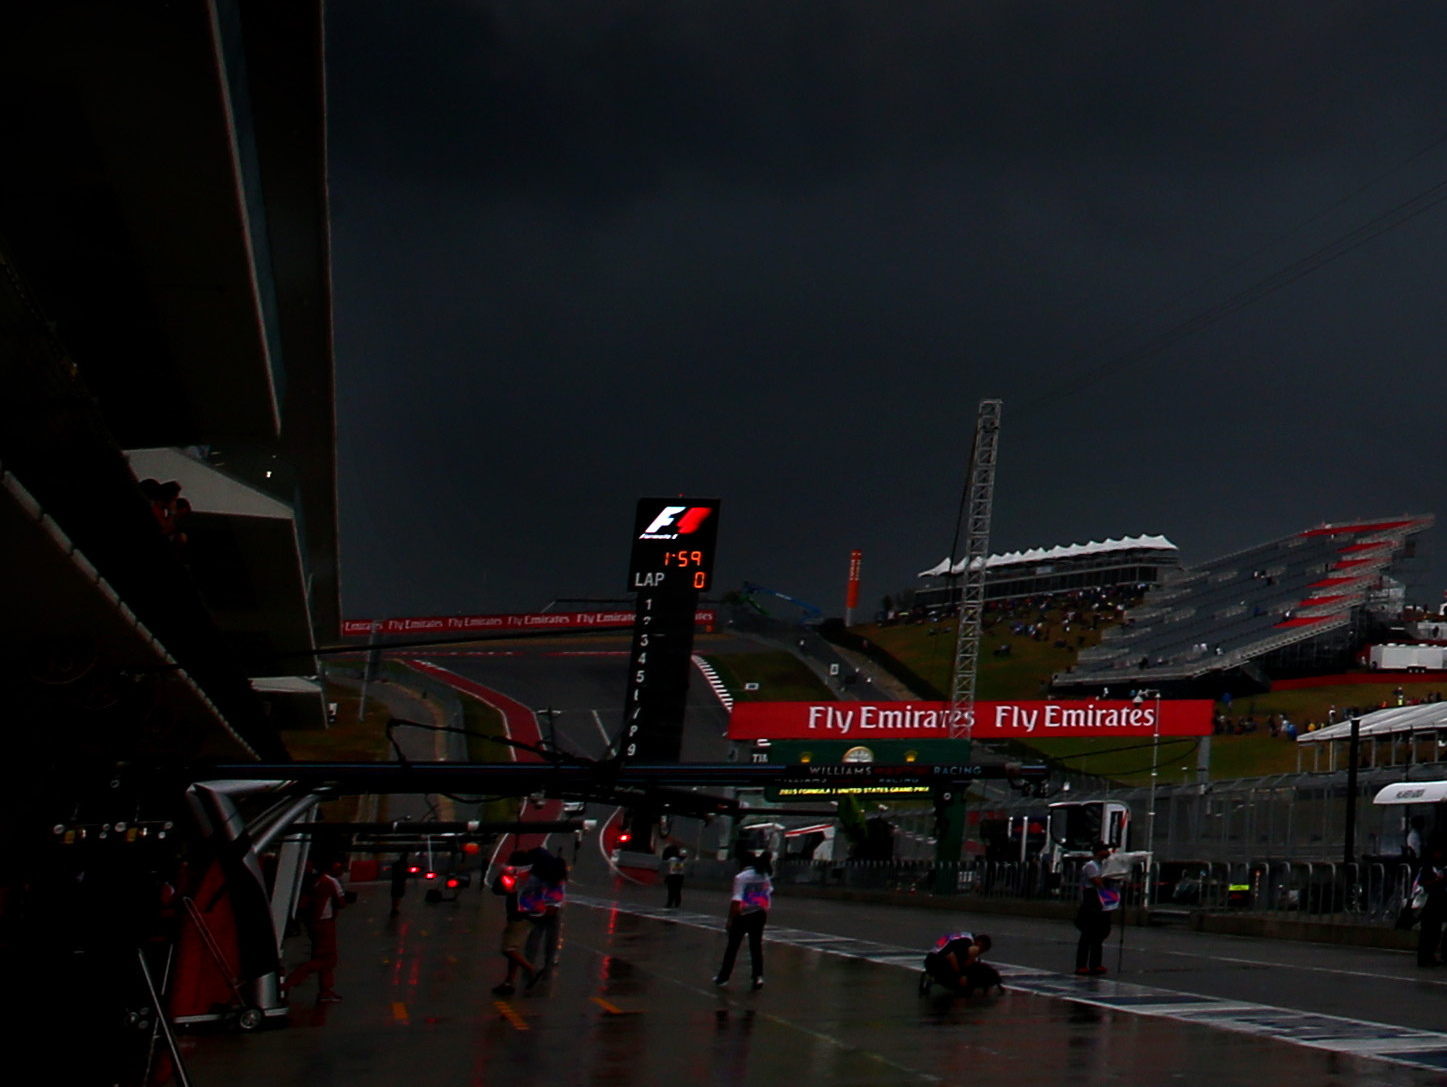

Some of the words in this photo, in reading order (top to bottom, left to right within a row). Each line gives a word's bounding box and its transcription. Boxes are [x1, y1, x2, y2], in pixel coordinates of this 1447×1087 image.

[634, 571, 665, 587] LAP
[693, 571, 706, 589] 0
[645, 598, 652, 611] 1
[524, 615, 571, 626] Emirates
[577, 613, 595, 625] Fly
[596, 612, 636, 624] Emirate
[639, 634, 649, 647] 3
[637, 652, 647, 665] 4
[635, 670, 646, 683] 5
[808, 706, 854, 734] Fly
[860, 705, 976, 729] Emirates
[995, 705, 1039, 733] Fly
[1044, 704, 1155, 728] Emirates
[626, 742, 637, 757] 9
[808, 765, 872, 776] WILLIAMS
[933, 765, 983, 776] RACING
